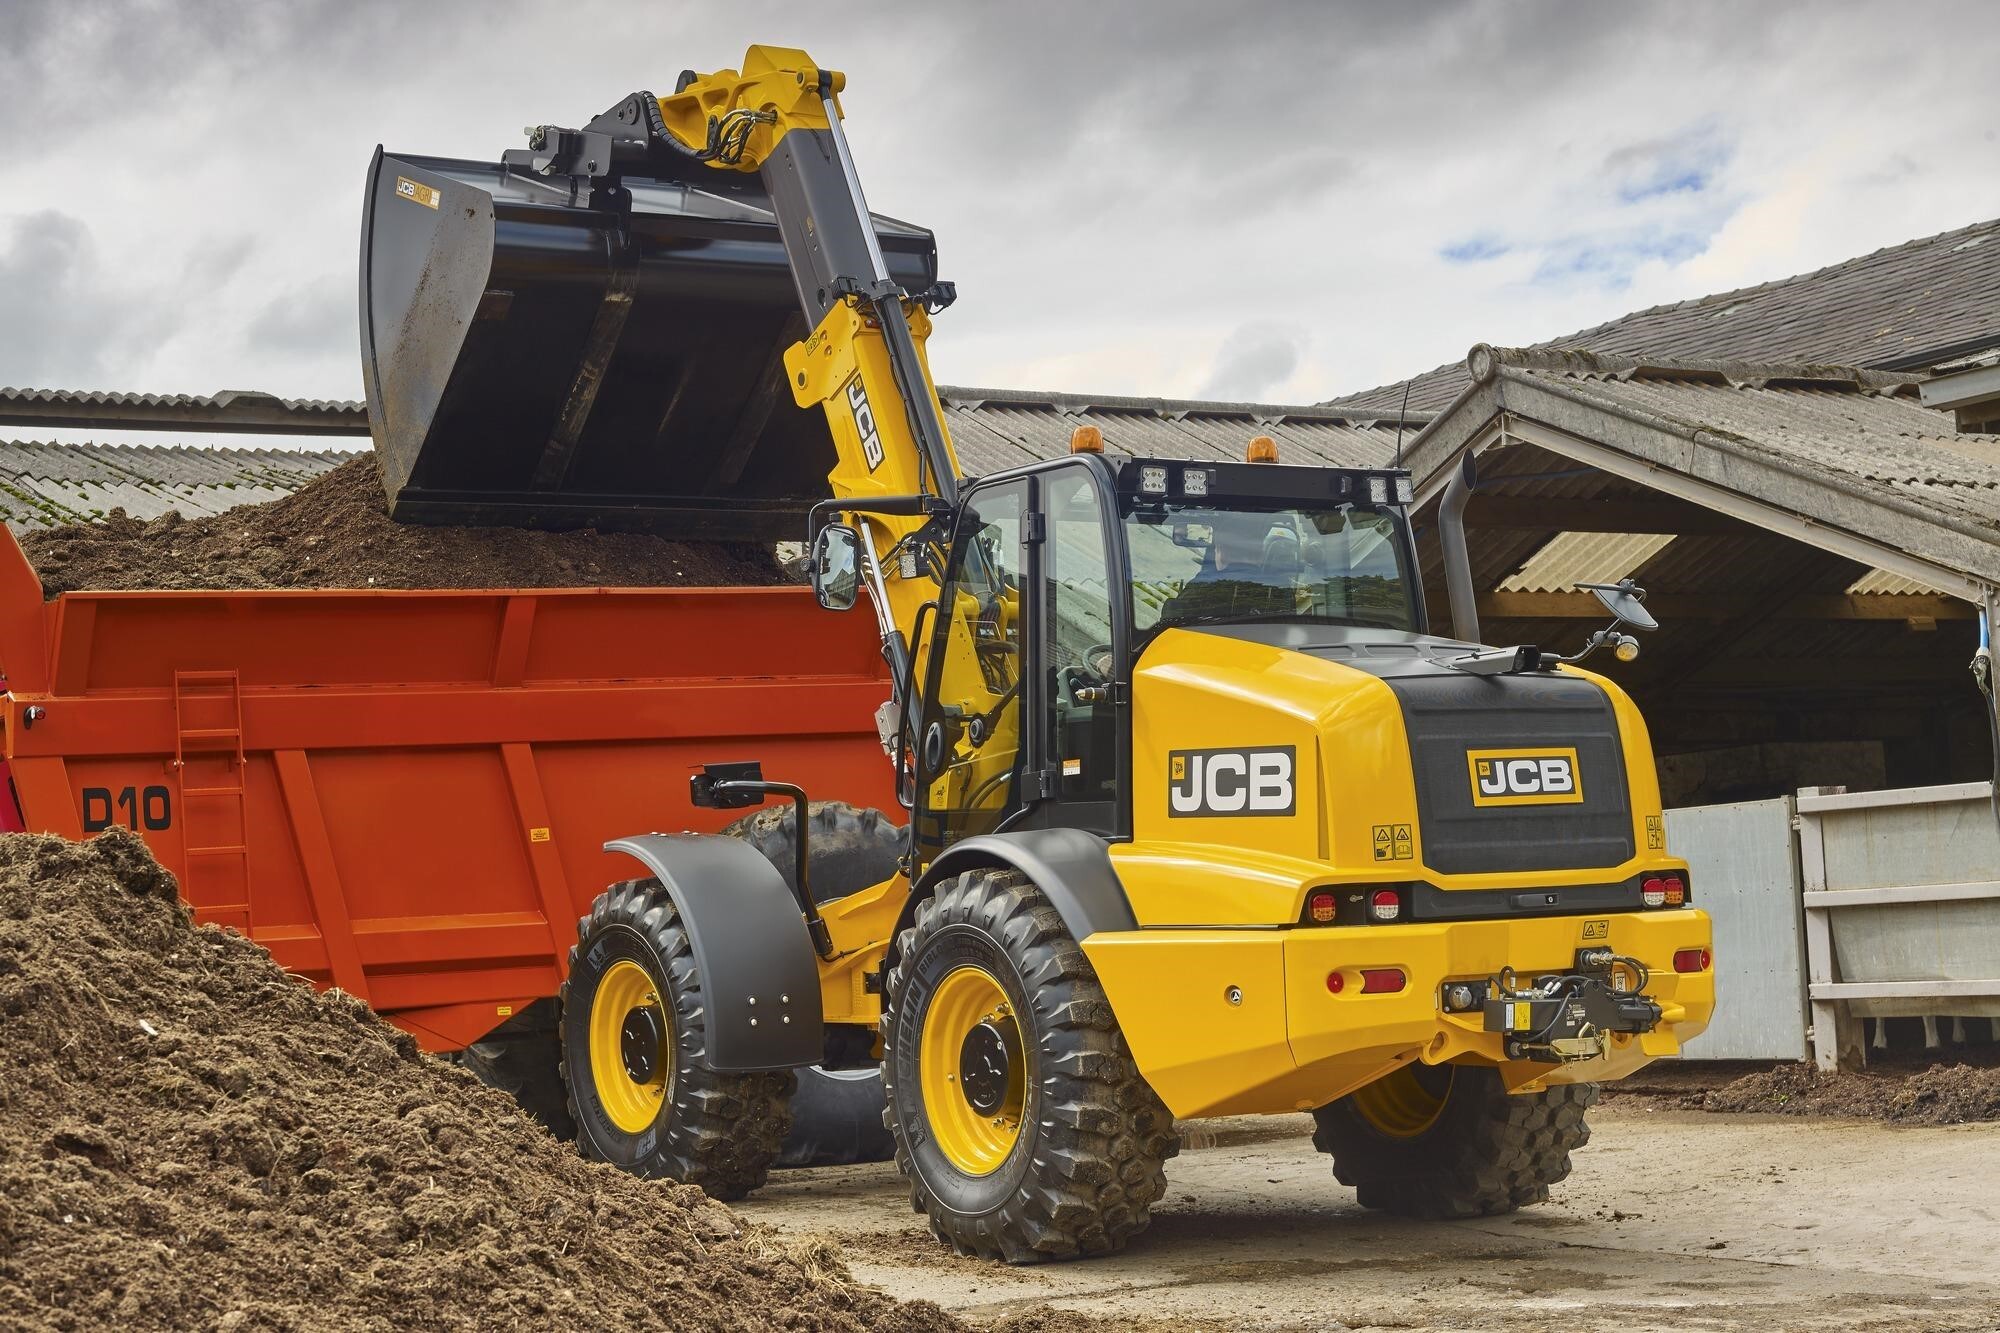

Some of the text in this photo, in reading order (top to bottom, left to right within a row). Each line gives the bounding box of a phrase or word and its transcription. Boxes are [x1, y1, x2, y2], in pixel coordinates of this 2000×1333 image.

[398, 180, 415, 196] JCB
[848, 383, 883, 470] JCB
[1171, 752, 1293, 812] JCB
[1480, 759, 1573, 794] JCB
[82, 785, 172, 832] D10
